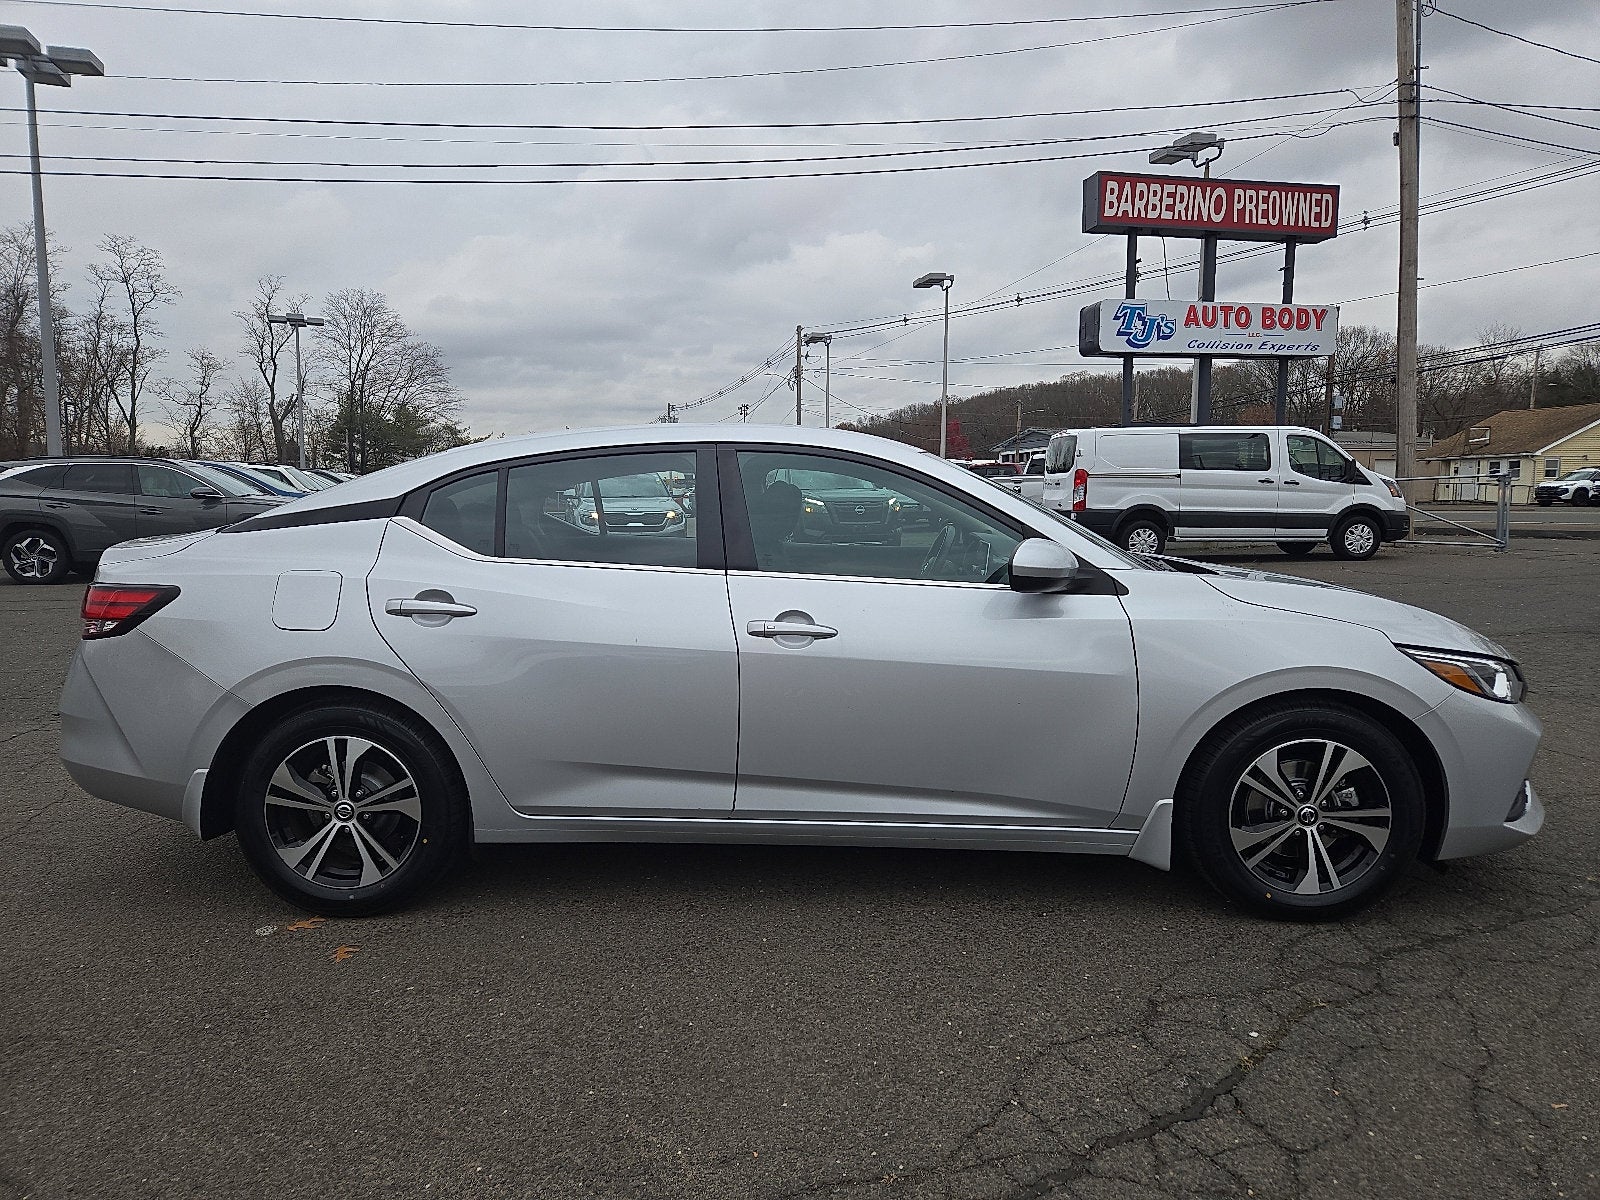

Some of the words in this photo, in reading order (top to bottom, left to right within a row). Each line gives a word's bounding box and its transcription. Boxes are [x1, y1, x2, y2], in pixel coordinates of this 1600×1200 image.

[1103, 181, 1227, 222] BARBERINO
[1233, 188, 1333, 228] PREOWNED
[1184, 304, 1252, 329] AUTO
[1261, 306, 1328, 331] BODY
[1186, 339, 1253, 351] Collision
[1258, 340, 1321, 354] Experts
